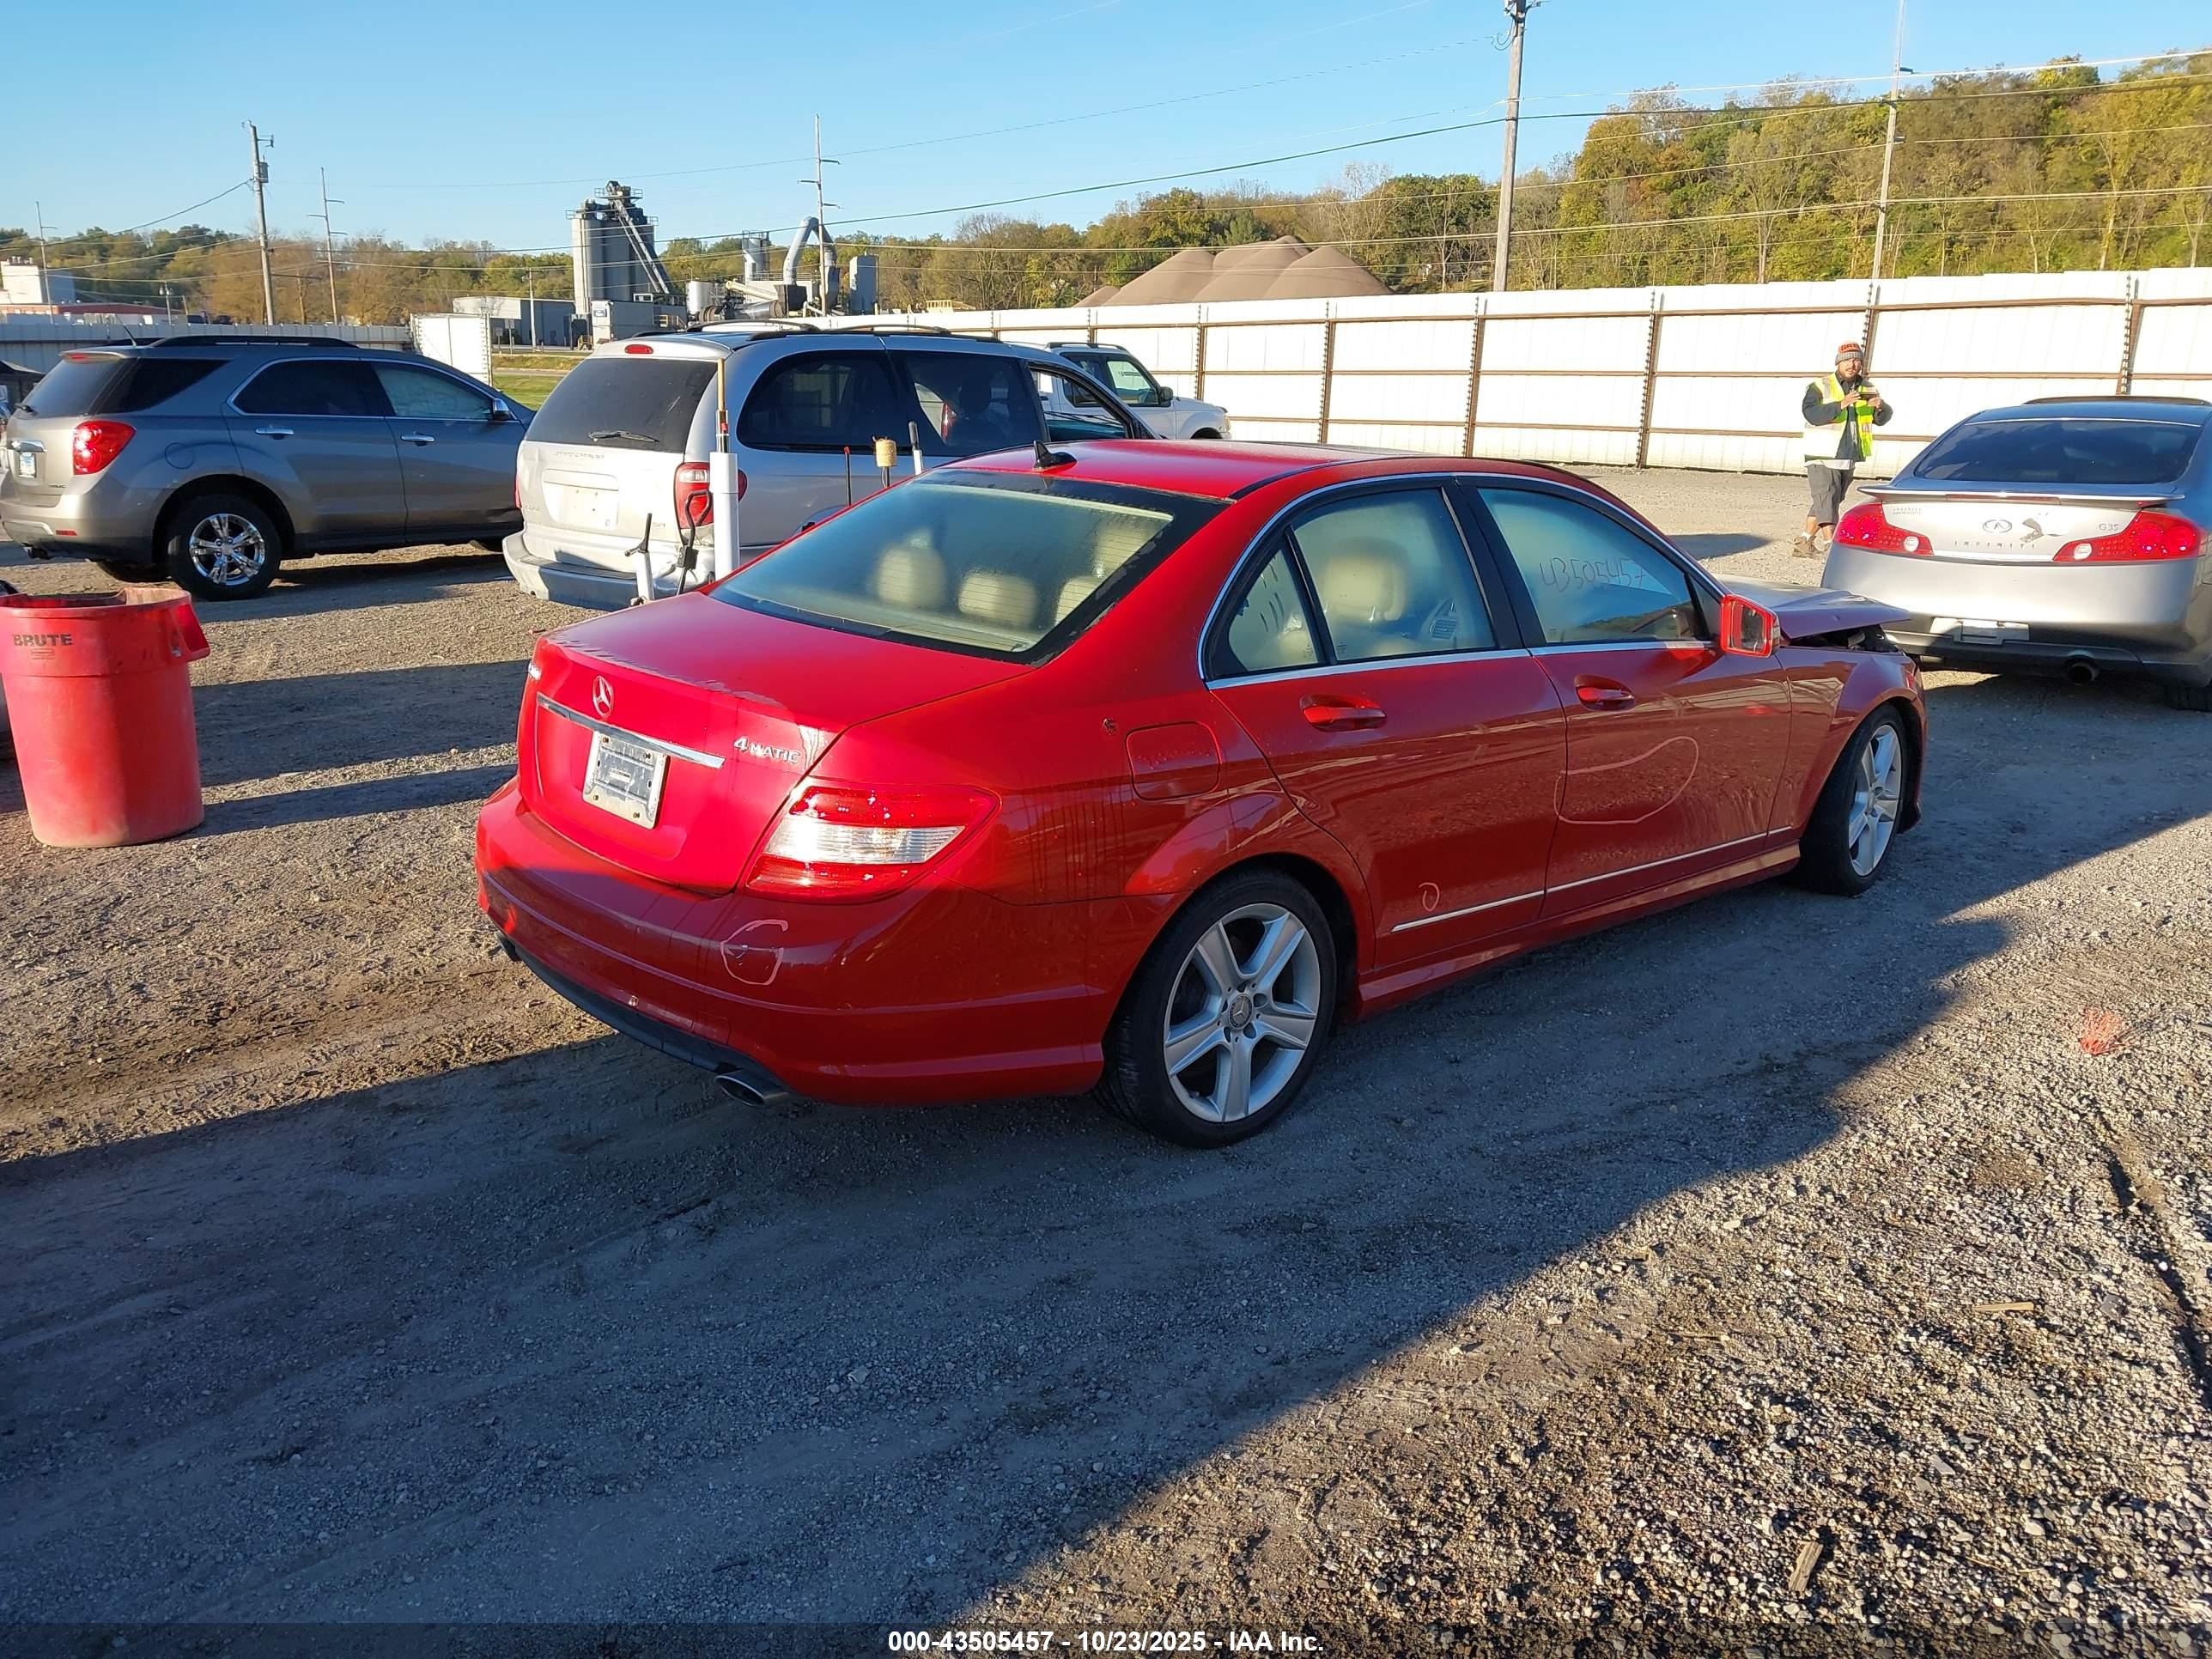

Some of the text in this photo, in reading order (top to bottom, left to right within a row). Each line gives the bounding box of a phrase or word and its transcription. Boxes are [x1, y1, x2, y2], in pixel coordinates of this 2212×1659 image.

[2098, 523, 2120, 532] G35
[1539, 556, 1646, 592] 43505457
[13, 633, 73, 647] BRUTE
